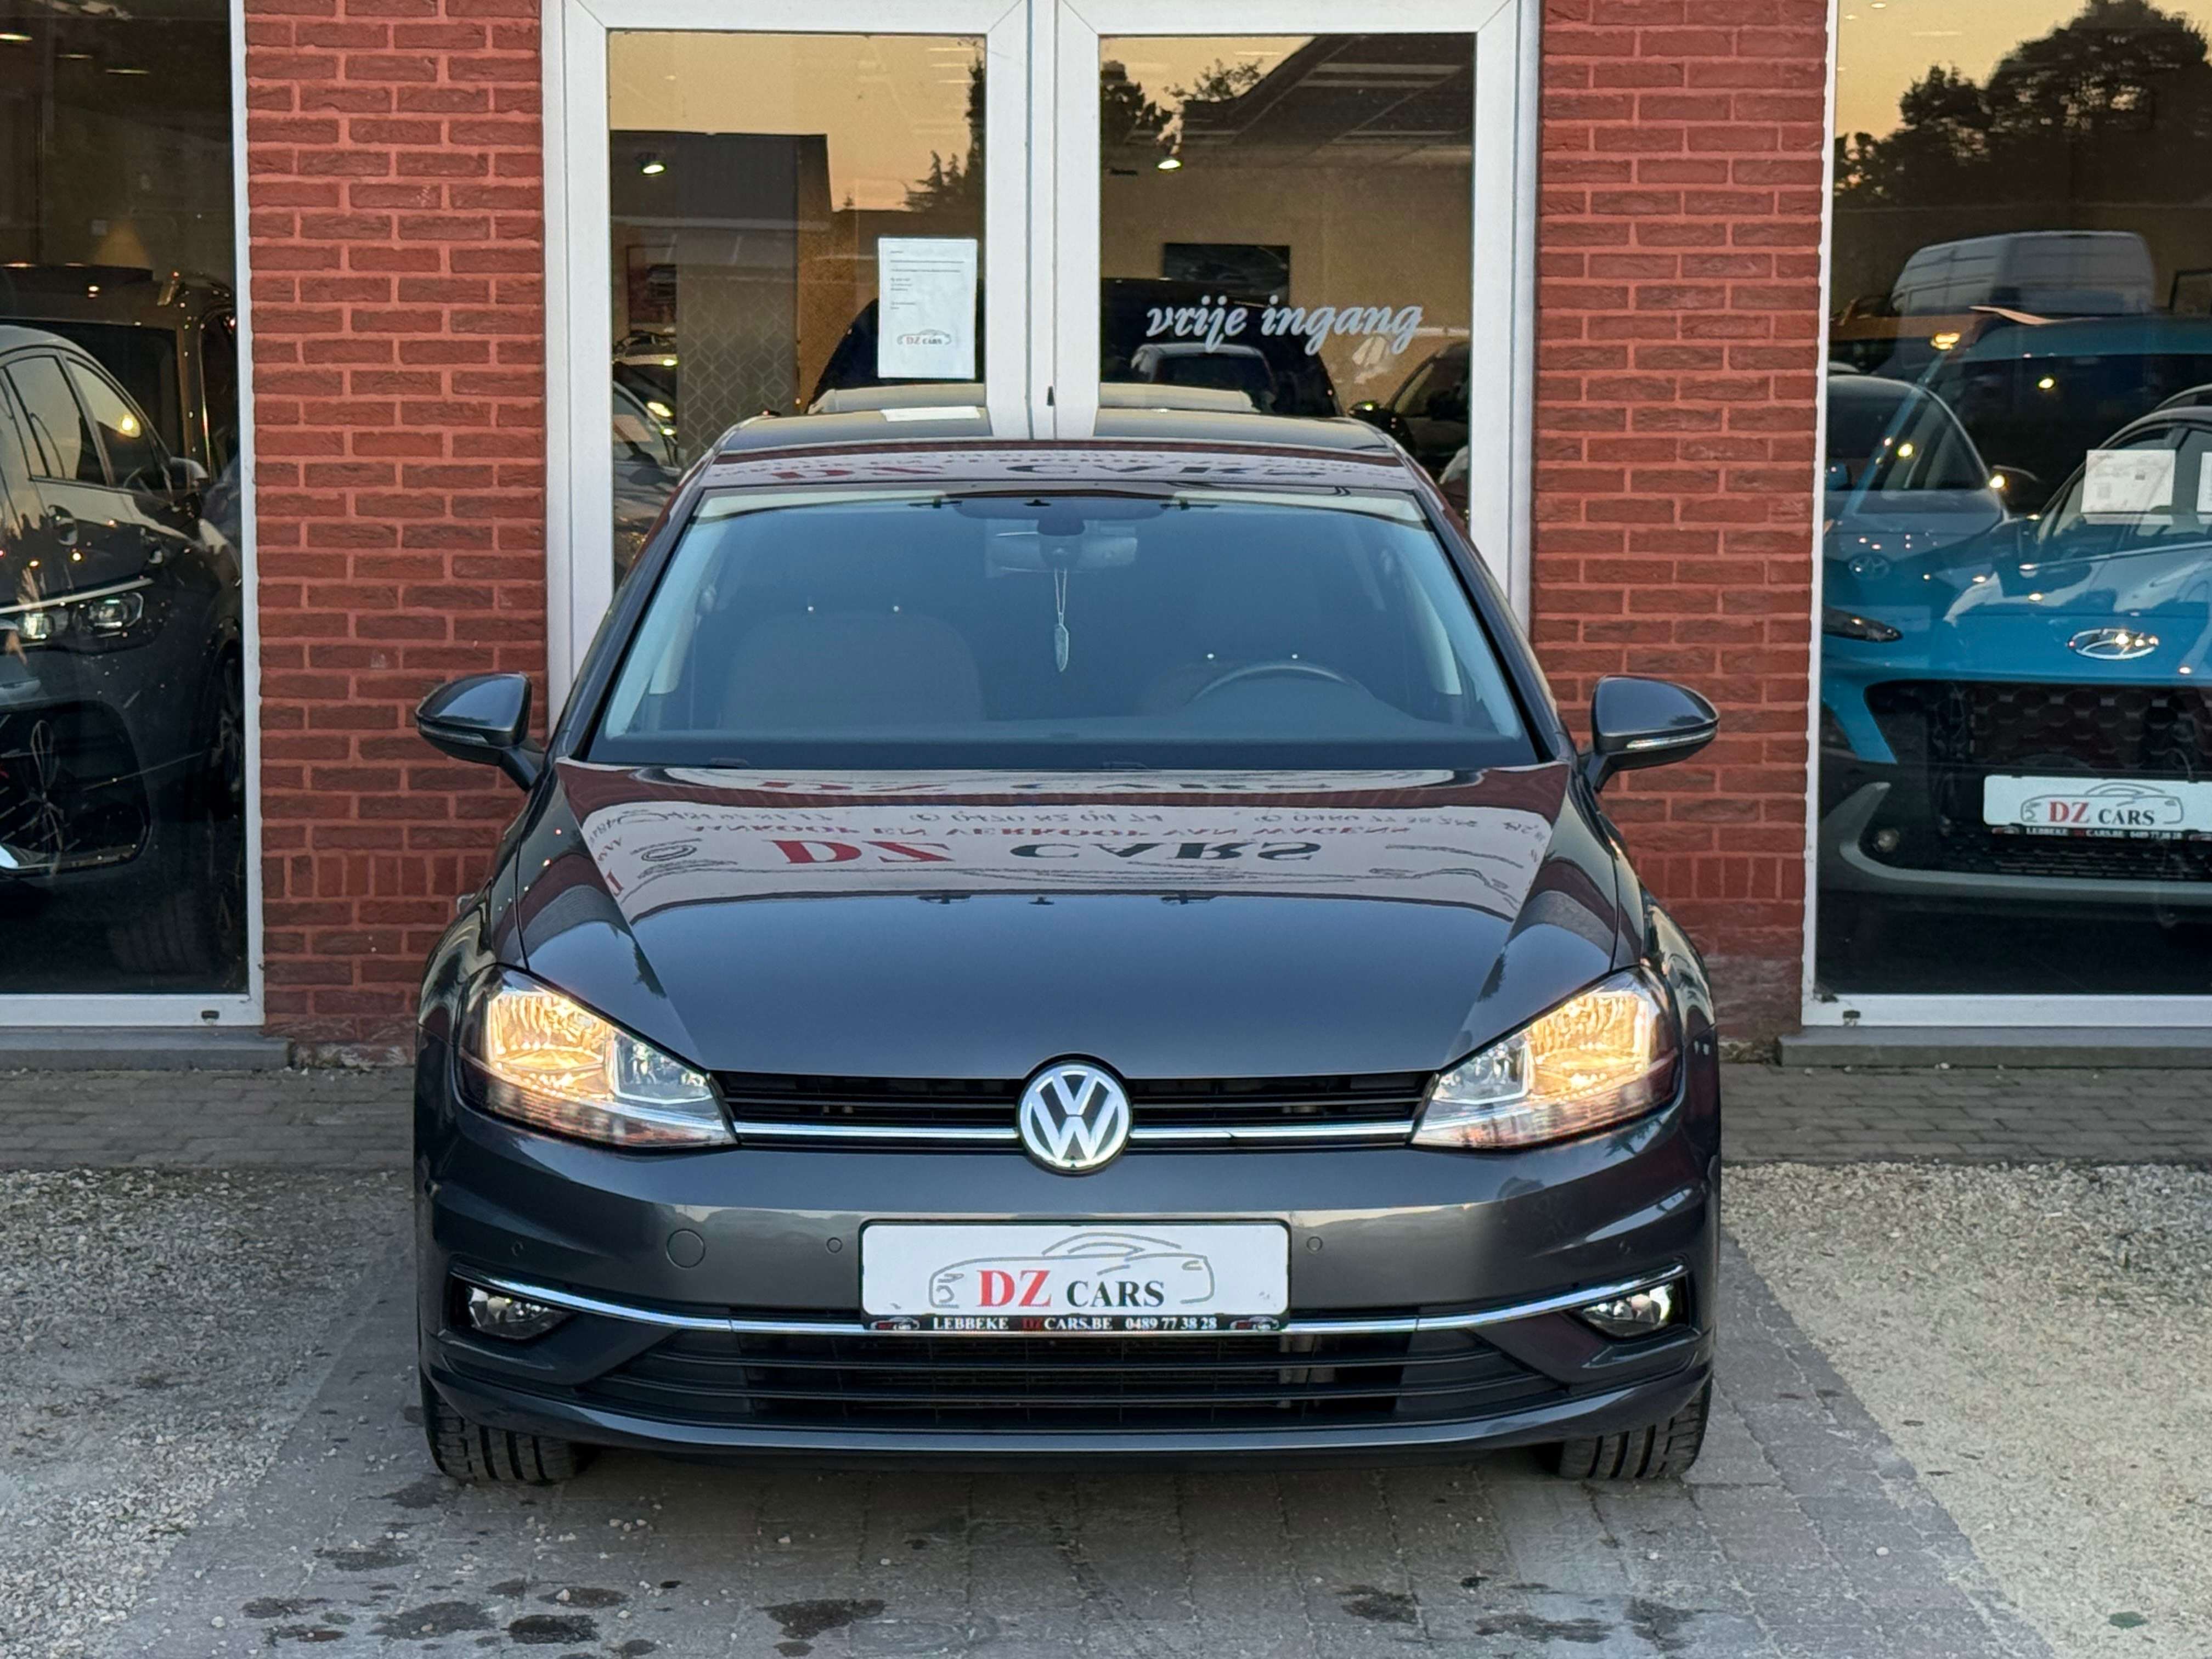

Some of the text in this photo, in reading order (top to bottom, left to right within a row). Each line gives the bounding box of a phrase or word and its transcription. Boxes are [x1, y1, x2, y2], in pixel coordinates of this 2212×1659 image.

[1146, 294, 1423, 356] vrije ingang
[906, 336, 943, 345] DZ CARS
[2049, 800, 2155, 826] DZ CARS
[977, 1269, 1165, 1308] DZ CARS
[933, 1317, 1008, 1330] LEBBEKE
[1125, 1317, 1158, 1330] 0489
[1161, 1317, 1177, 1330] 77
[1180, 1317, 1198, 1330] 38
[1200, 1317, 1217, 1330] 28
